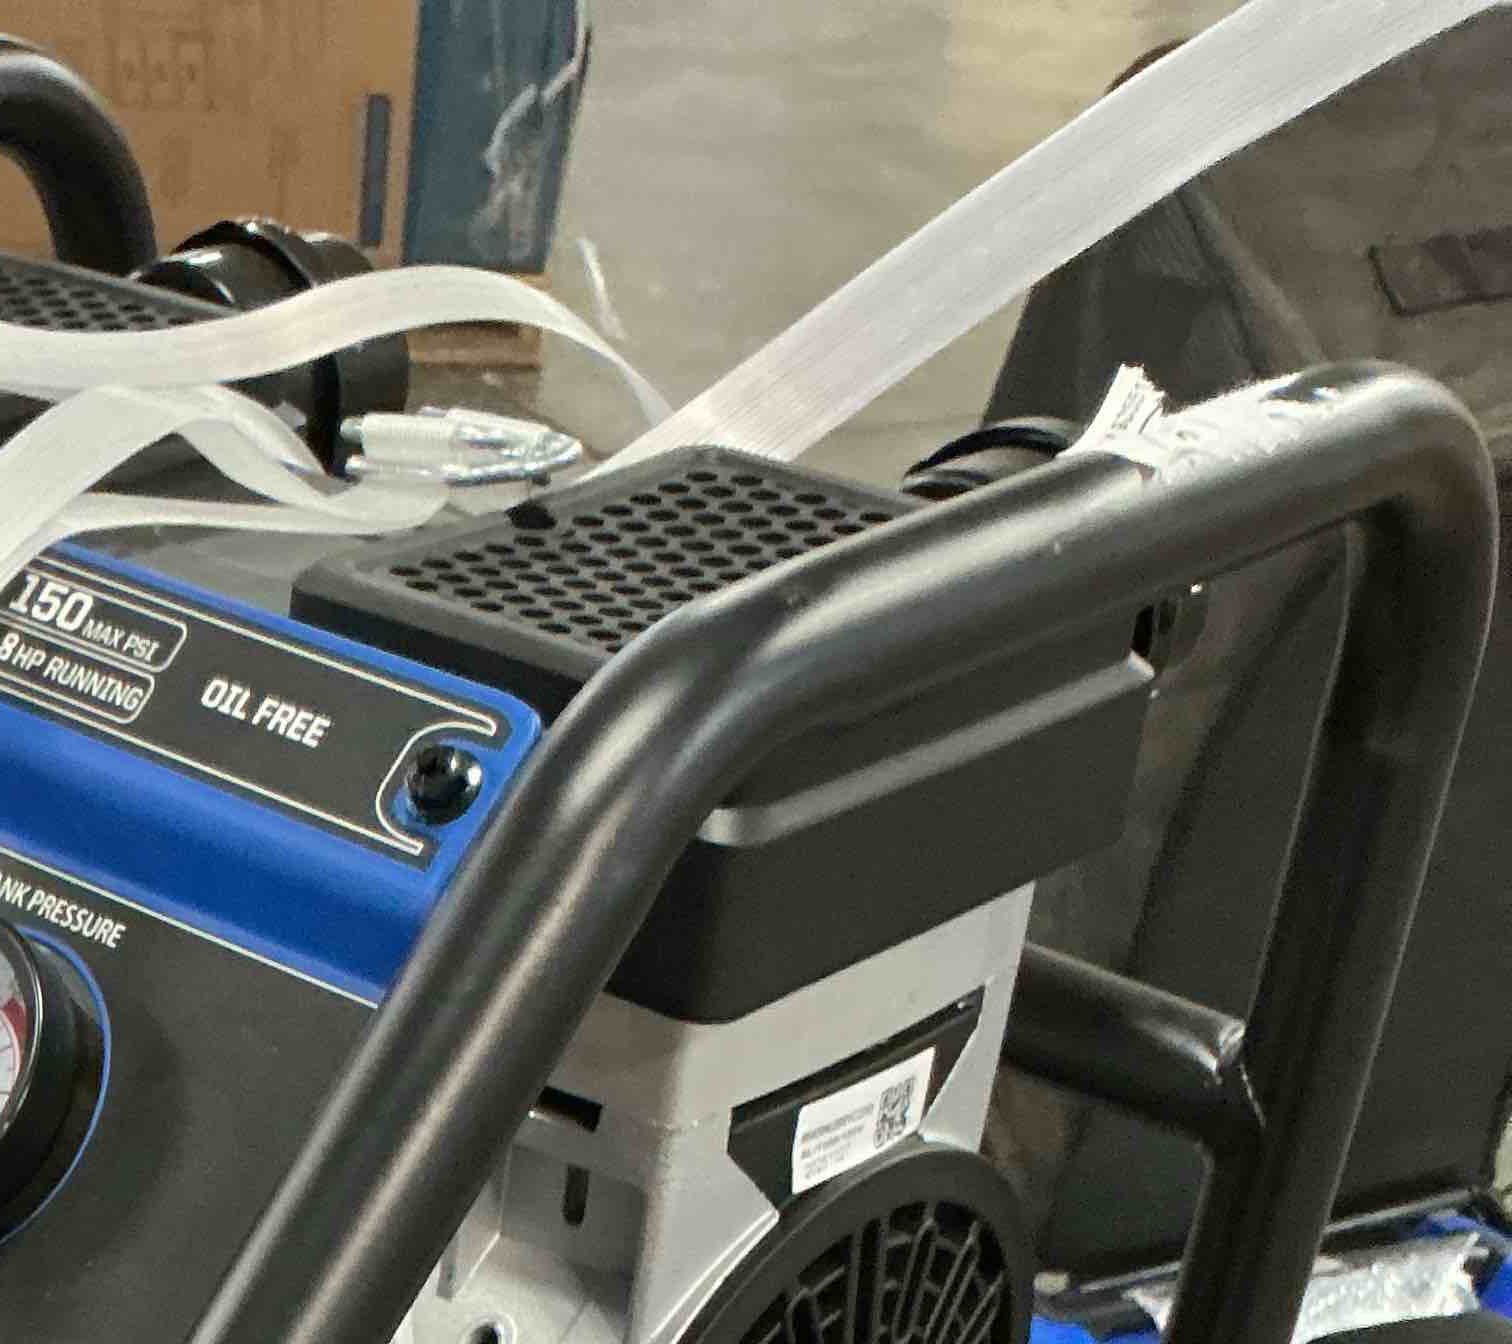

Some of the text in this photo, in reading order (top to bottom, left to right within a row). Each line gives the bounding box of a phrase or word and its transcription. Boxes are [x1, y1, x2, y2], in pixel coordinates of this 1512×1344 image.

[123, 634, 160, 663] PSI
[43, 655, 144, 711] RUNNING
[200, 679, 331, 749] OIL FREE
[26, 889, 127, 948] PRESSURE
